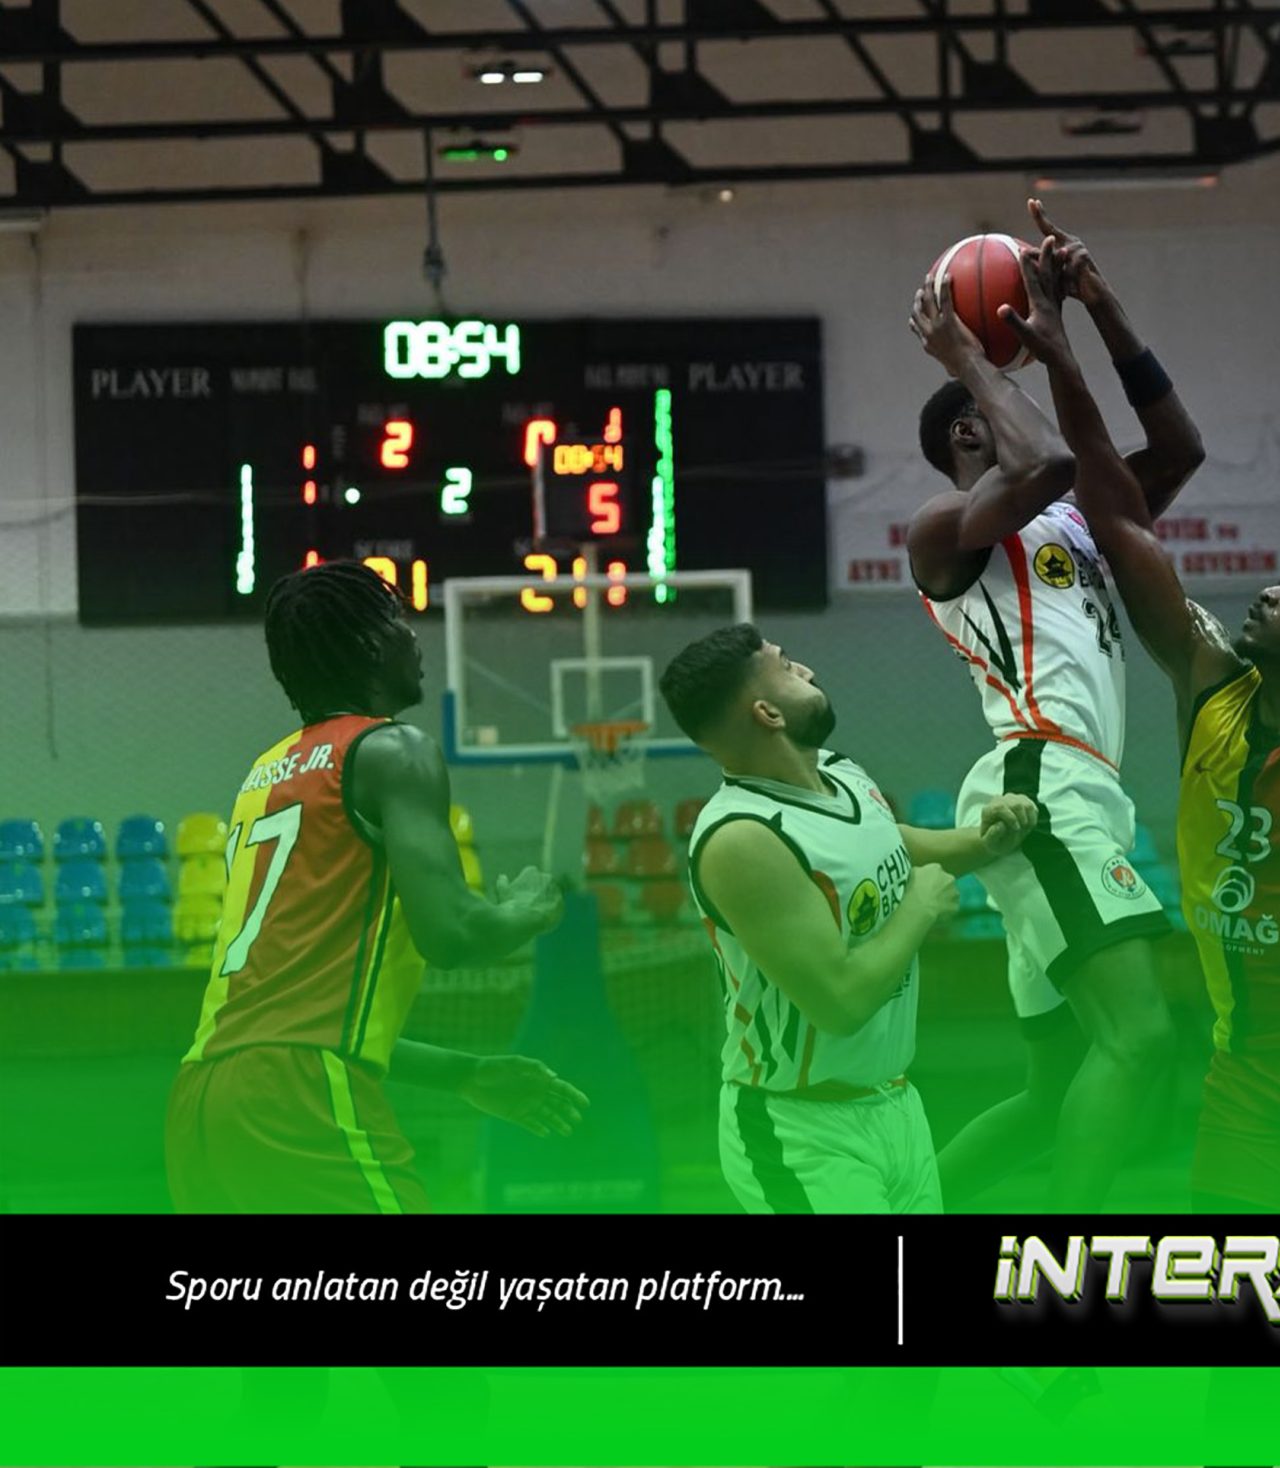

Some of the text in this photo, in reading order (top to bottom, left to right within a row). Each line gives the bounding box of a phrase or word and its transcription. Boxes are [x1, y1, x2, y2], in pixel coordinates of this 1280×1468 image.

[383, 320, 521, 379] 08:54
[91, 367, 210, 399] PLAYER
[686, 362, 806, 392] PLAYER
[380, 418, 414, 469] 2
[440, 467, 473, 515] 2
[588, 482, 621, 535] 5
[299, 743, 335, 774] JR.
[1215, 799, 1273, 863] 23
